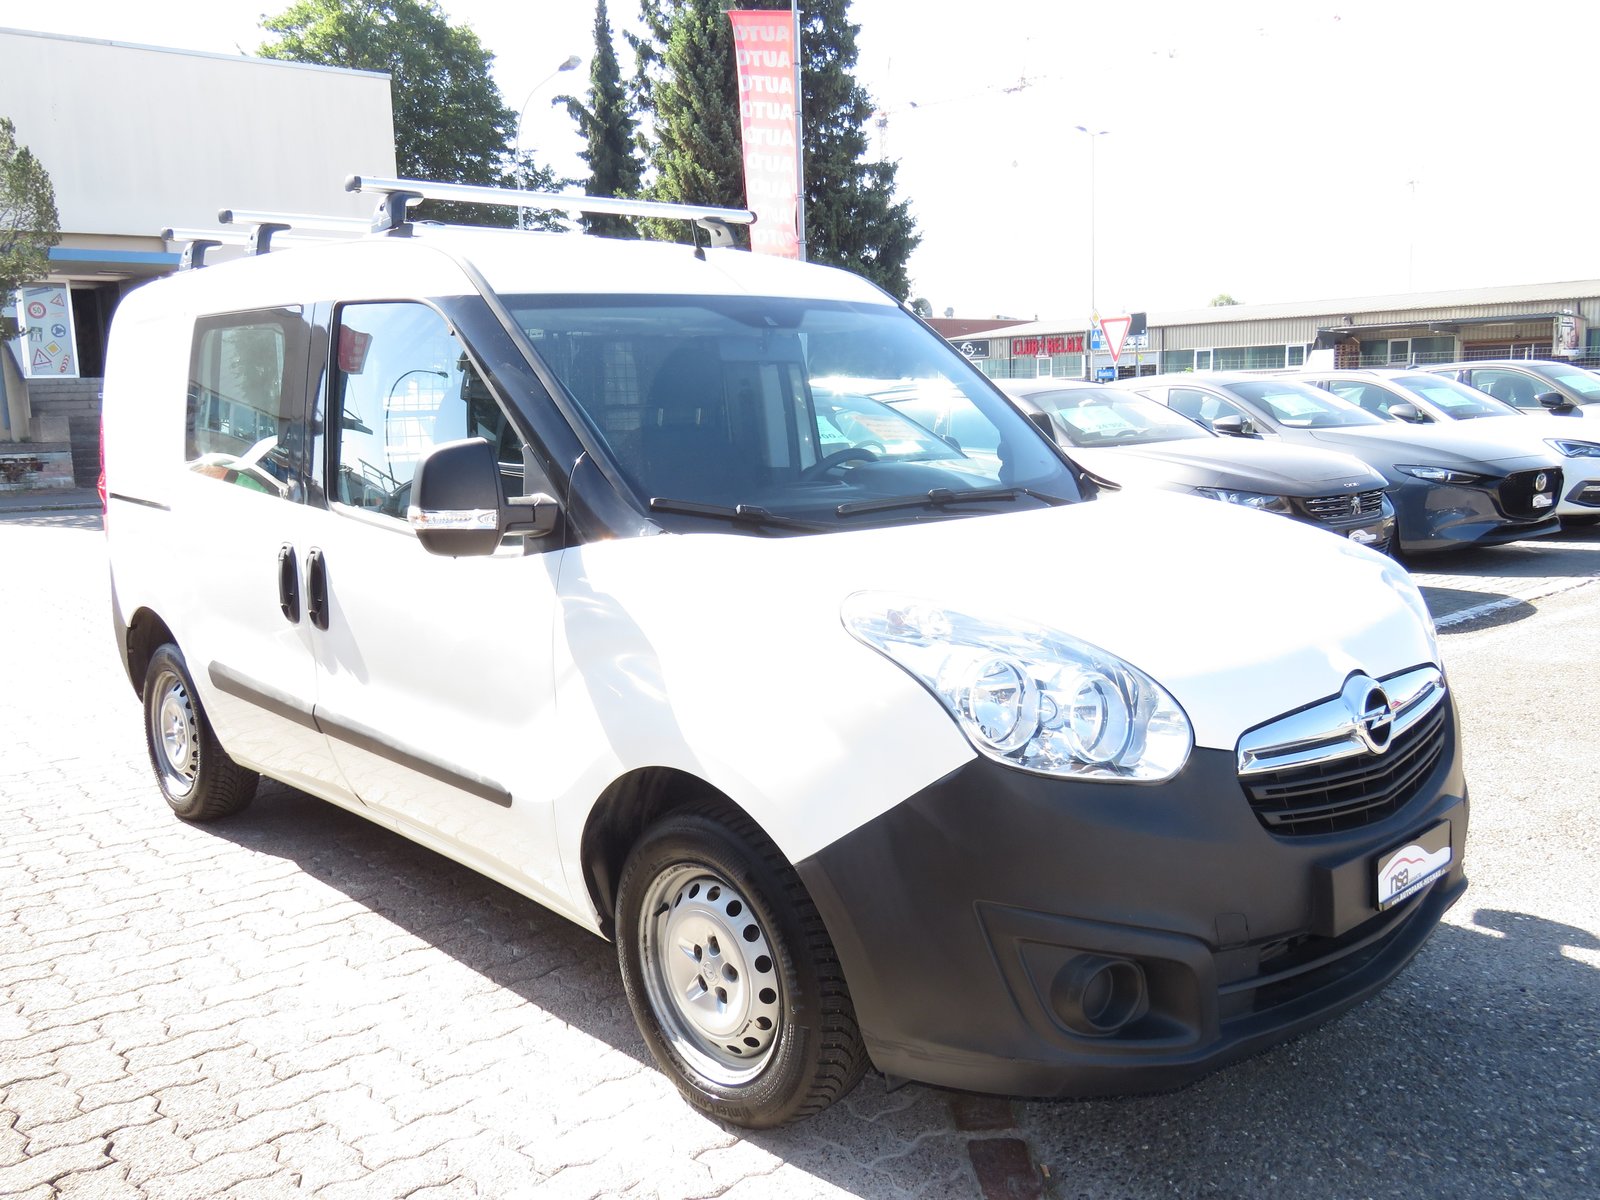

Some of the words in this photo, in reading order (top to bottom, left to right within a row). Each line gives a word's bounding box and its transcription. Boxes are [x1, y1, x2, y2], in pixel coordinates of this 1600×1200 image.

[32, 304, 42, 314] 50
[1013, 339, 1038, 355] CLUB
[1047, 336, 1083, 353] RELAX
